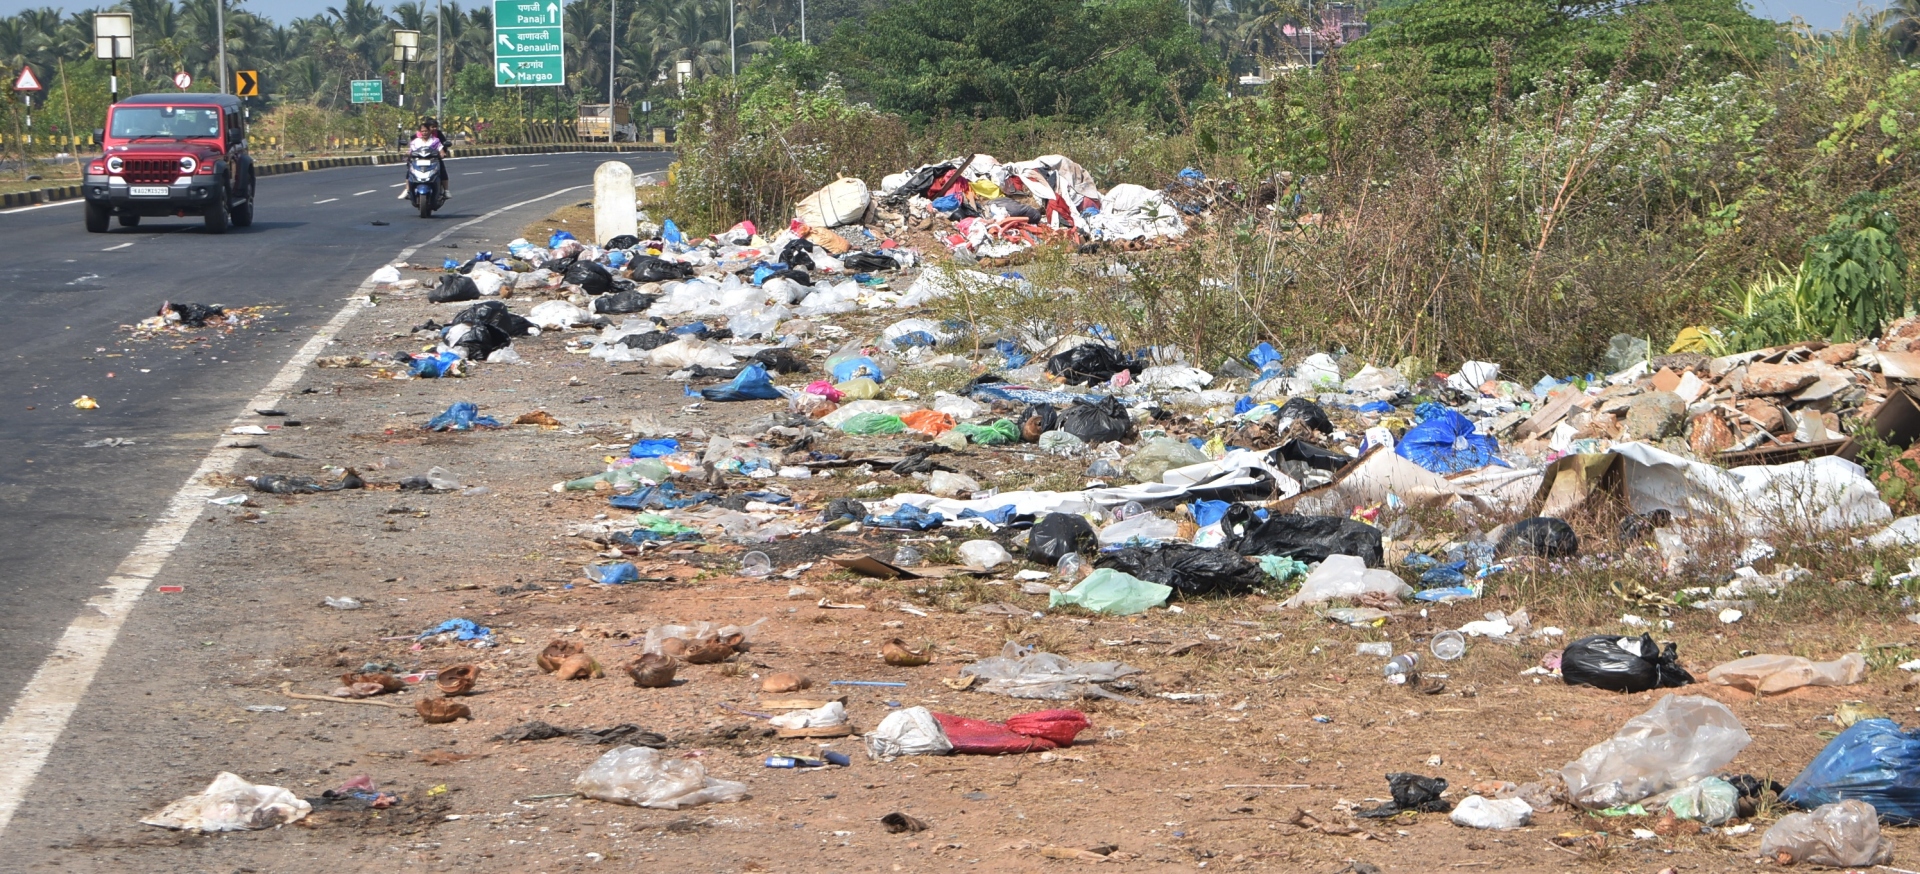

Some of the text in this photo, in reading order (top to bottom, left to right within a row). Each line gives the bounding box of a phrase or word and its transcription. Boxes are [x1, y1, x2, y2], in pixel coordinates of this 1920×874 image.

[517, 2, 540, 12] पणजी
[517, 15, 546, 24] Panaji
[517, 43, 559, 52] Benaulim
[517, 72, 553, 82] Margao
